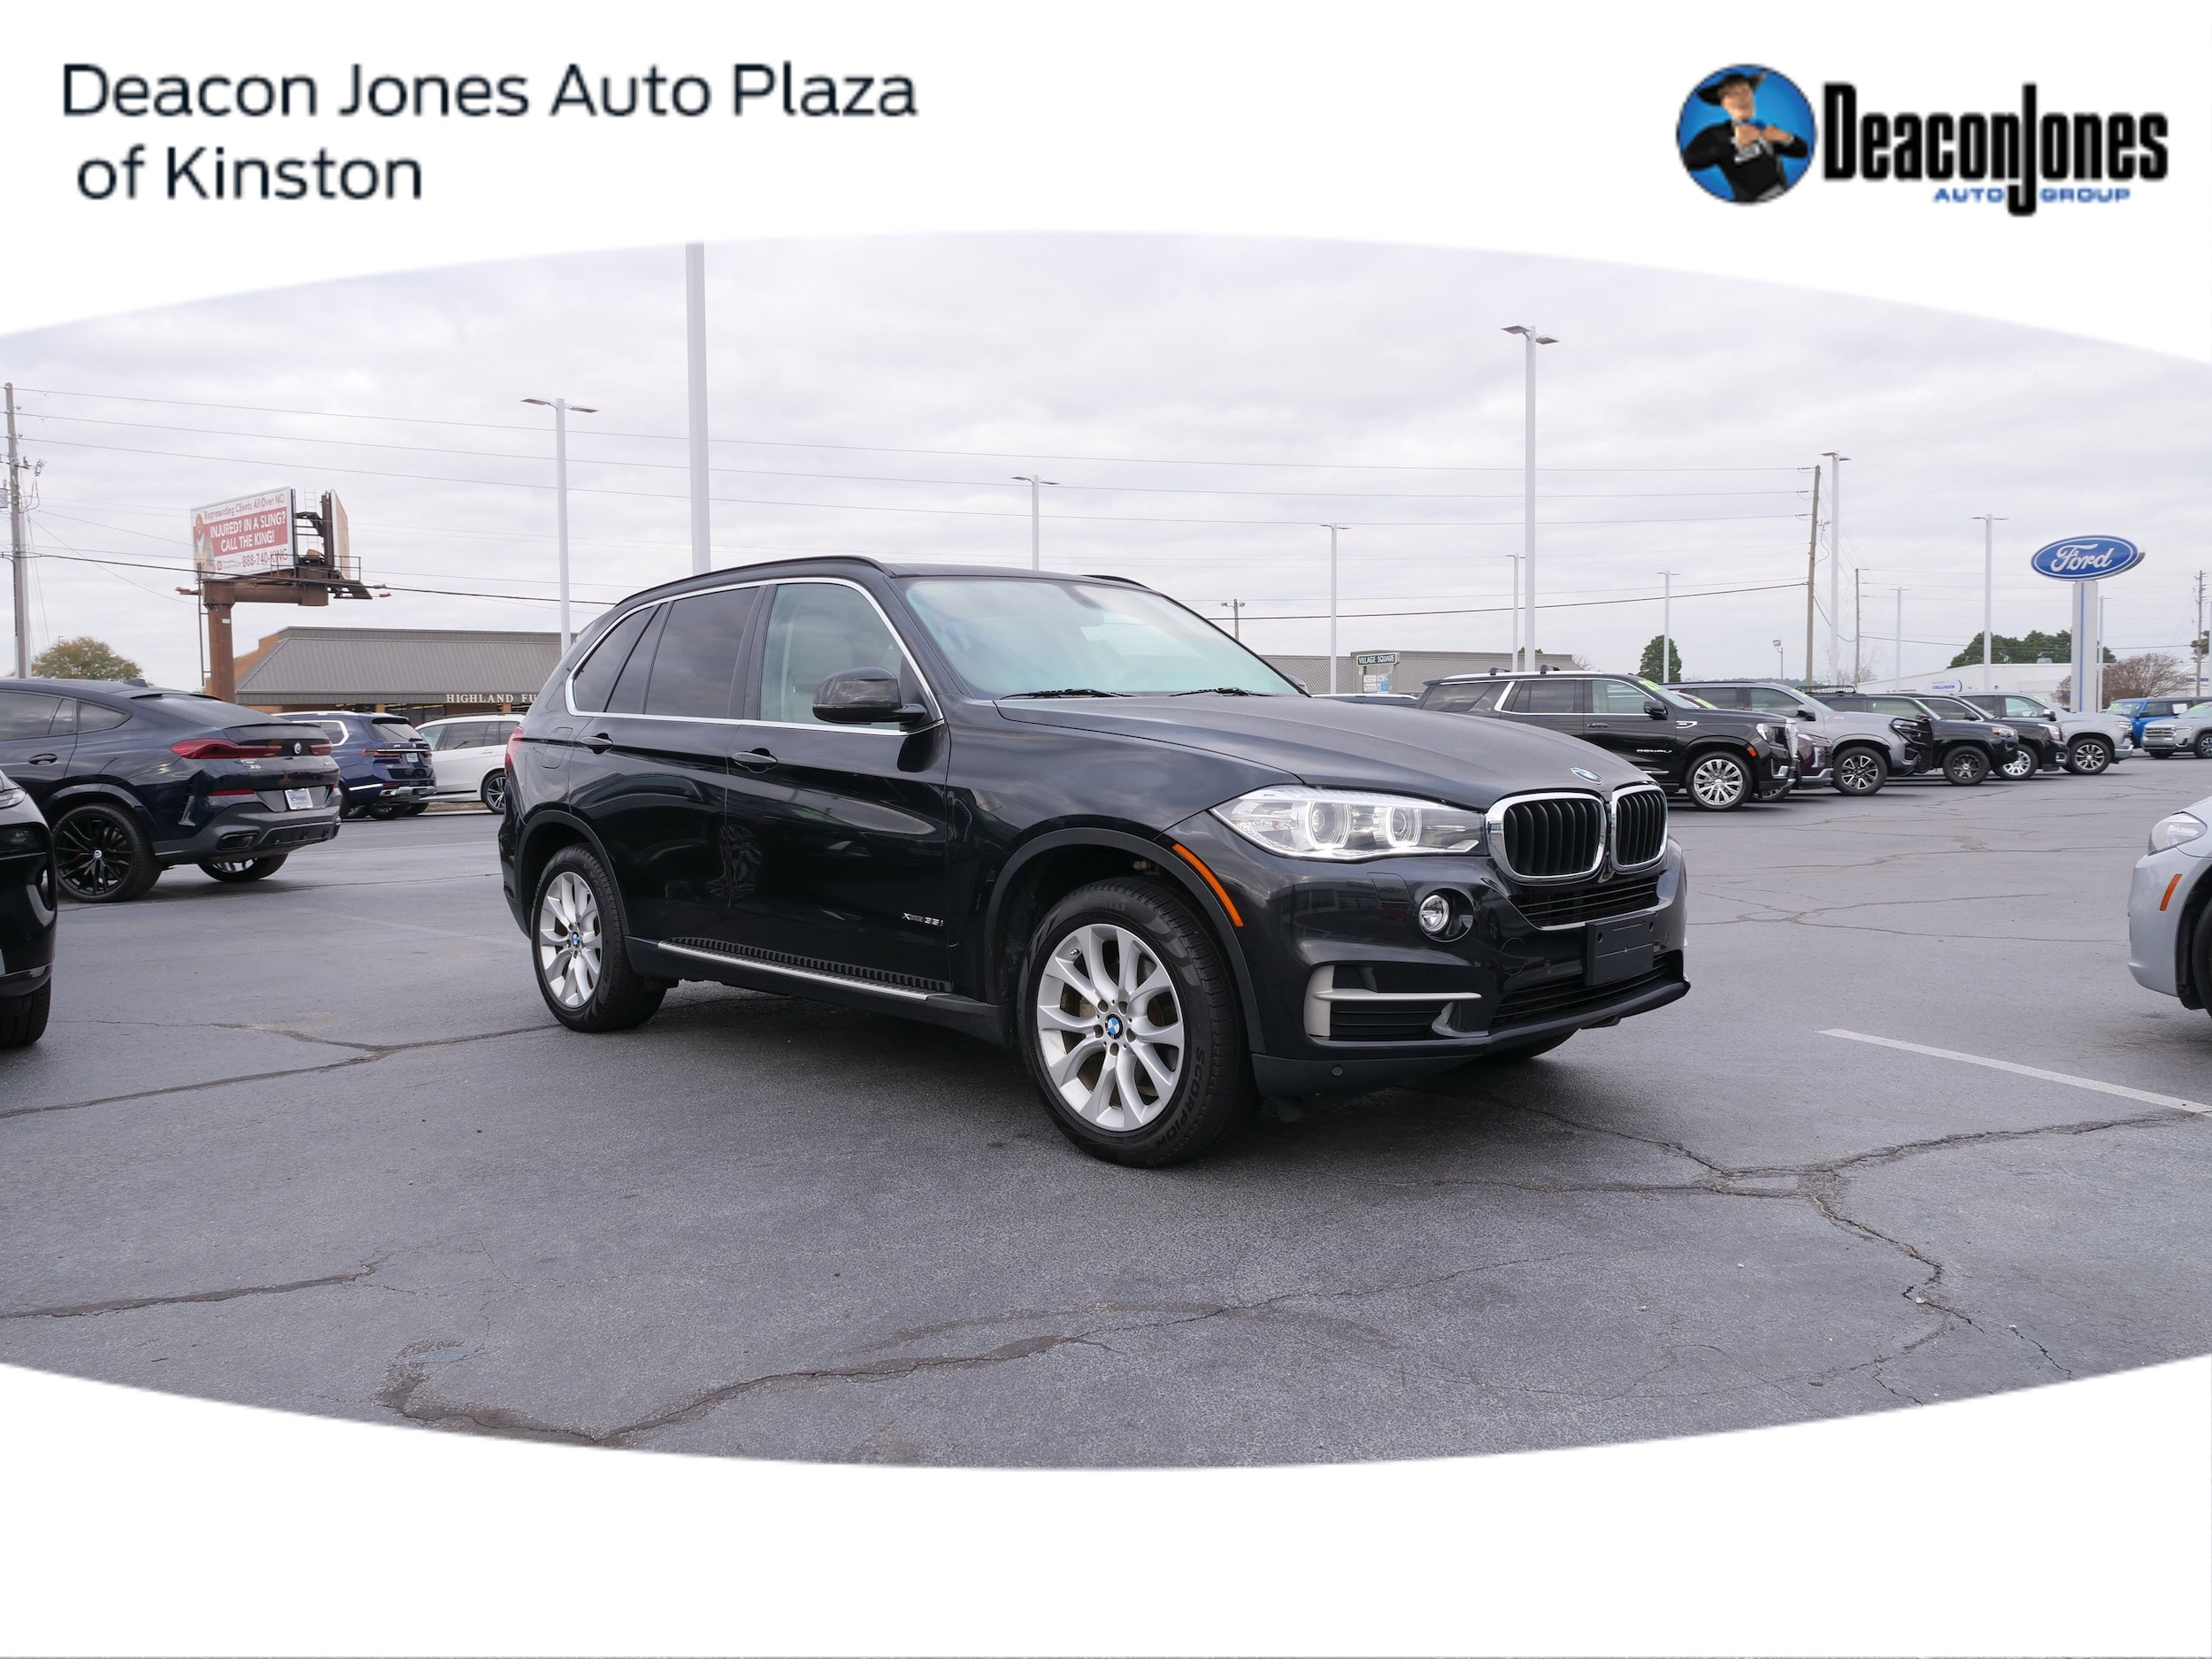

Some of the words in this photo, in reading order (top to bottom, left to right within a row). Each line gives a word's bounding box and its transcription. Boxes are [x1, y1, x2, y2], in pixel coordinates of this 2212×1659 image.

[204, 506, 234, 519] Representing
[235, 503, 252, 512] Clients
[261, 497, 274, 507] Over
[275, 494, 285, 504] NC!
[211, 519, 242, 539] INJURED?
[244, 518, 252, 532] IN
[253, 518, 259, 529] A
[260, 511, 286, 527] SLING?
[221, 537, 238, 552] CALL
[239, 534, 253, 549] THE
[254, 530, 275, 546] KING!
[2050, 543, 2115, 572] Ford
[446, 694, 514, 703] HIGHLAND
